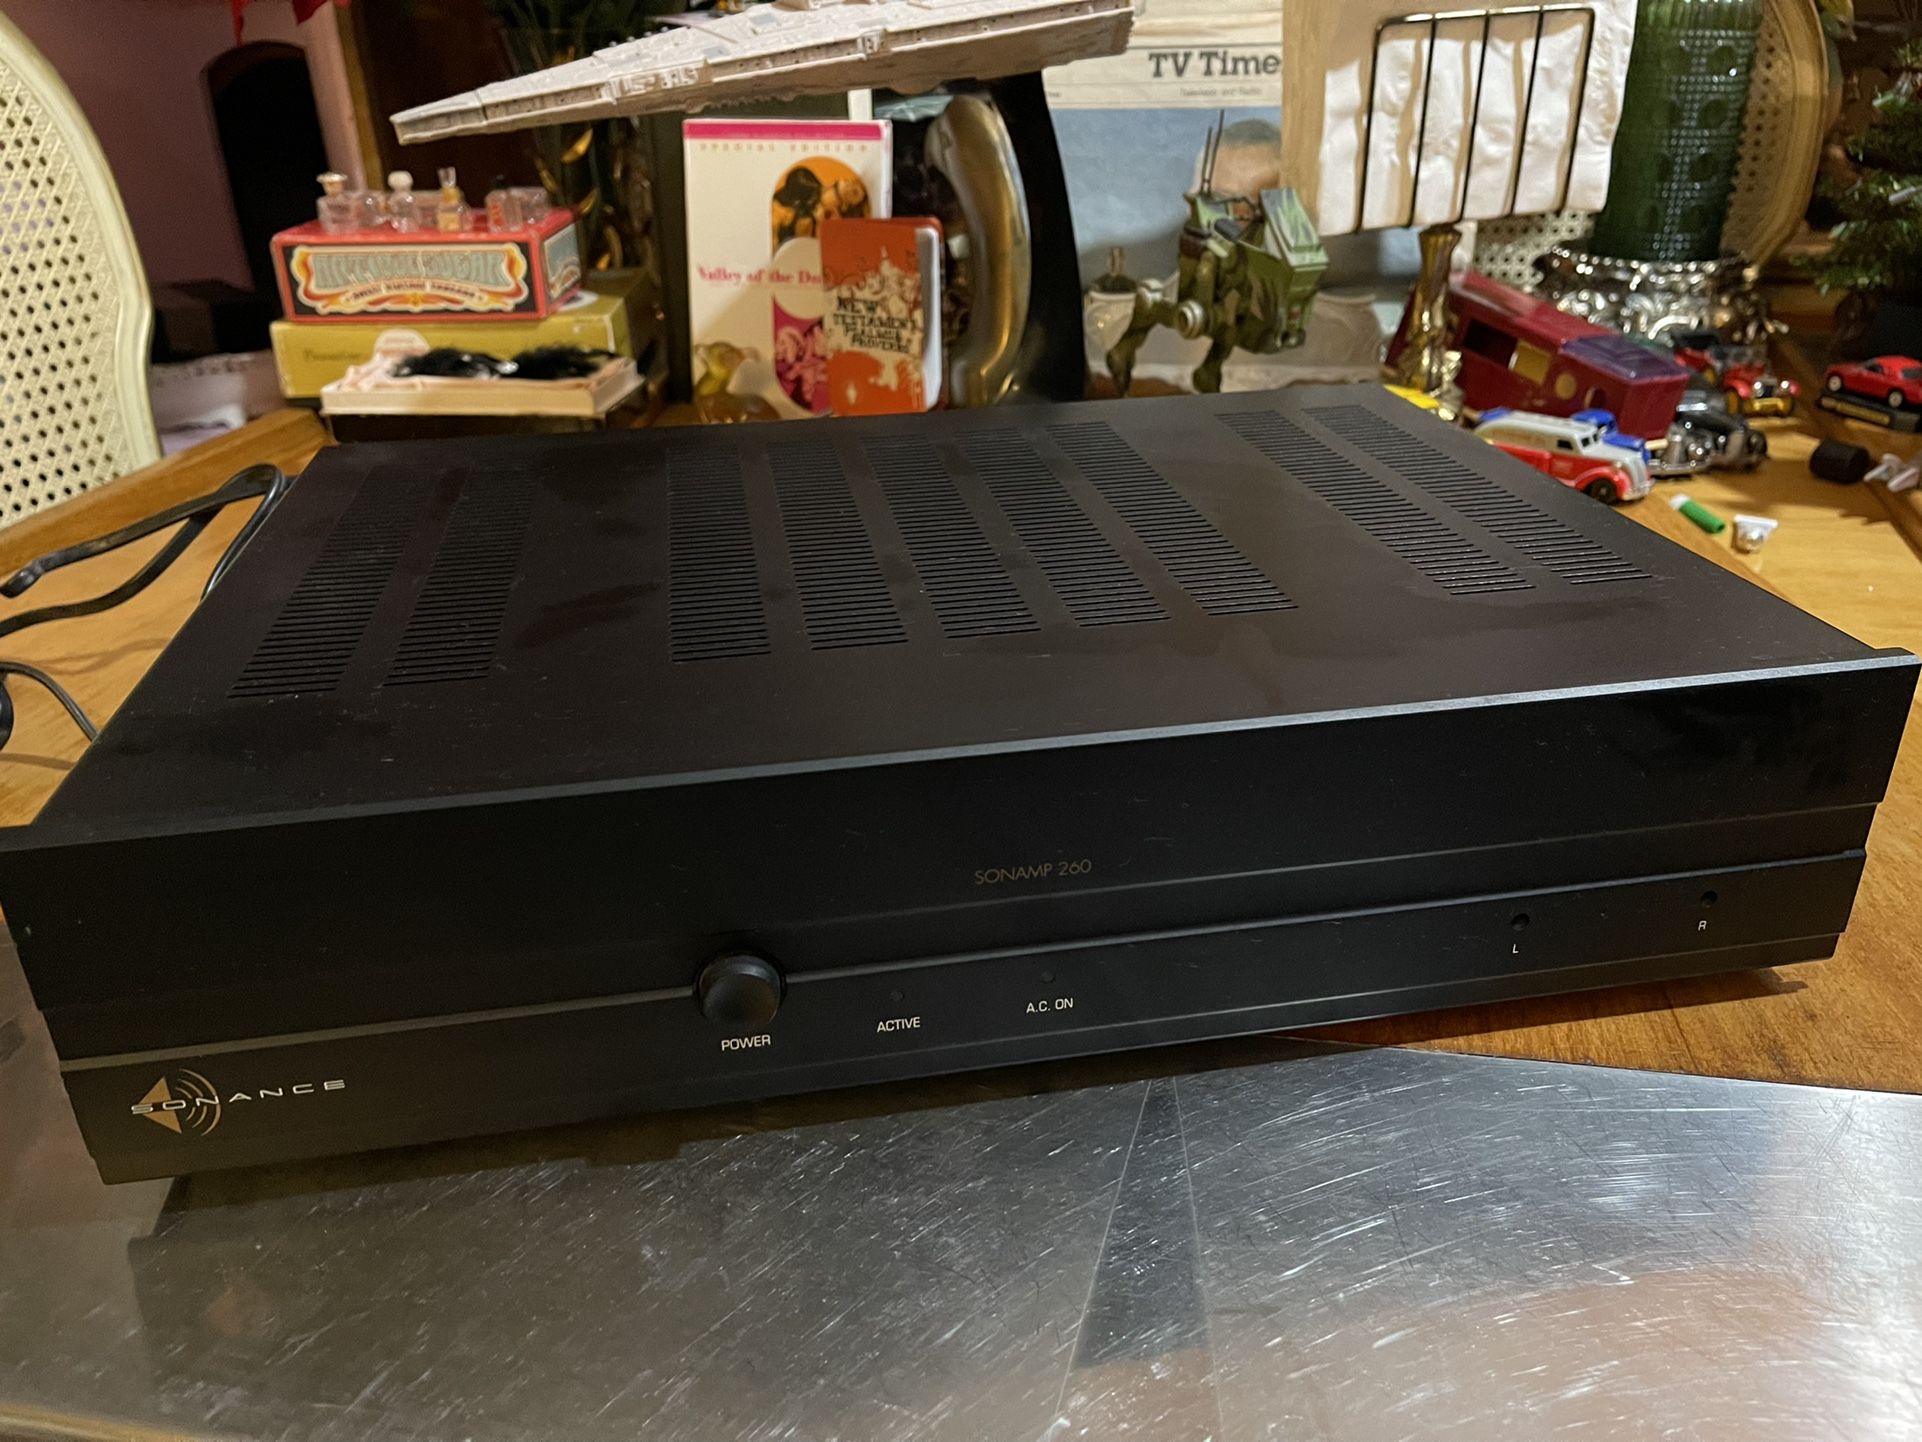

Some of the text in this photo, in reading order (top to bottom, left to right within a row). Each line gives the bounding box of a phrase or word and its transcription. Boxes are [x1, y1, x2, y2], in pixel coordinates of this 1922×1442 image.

[1148, 50, 1192, 77] TV
[697, 265, 742, 285] Valley
[746, 267, 764, 282] of
[767, 267, 793, 283] the
[836, 296, 881, 314] NEW
[833, 314, 916, 333] TESTAMENT
[975, 858, 1092, 885] SONAMP 260
[1697, 919, 1707, 931] R
[1512, 943, 1519, 954] L
[1026, 997, 1074, 1013] A.C. ON
[876, 1016, 921, 1033] ACTIVE
[721, 1034, 771, 1051] POWER
[131, 1079, 345, 1115] SONANCE
